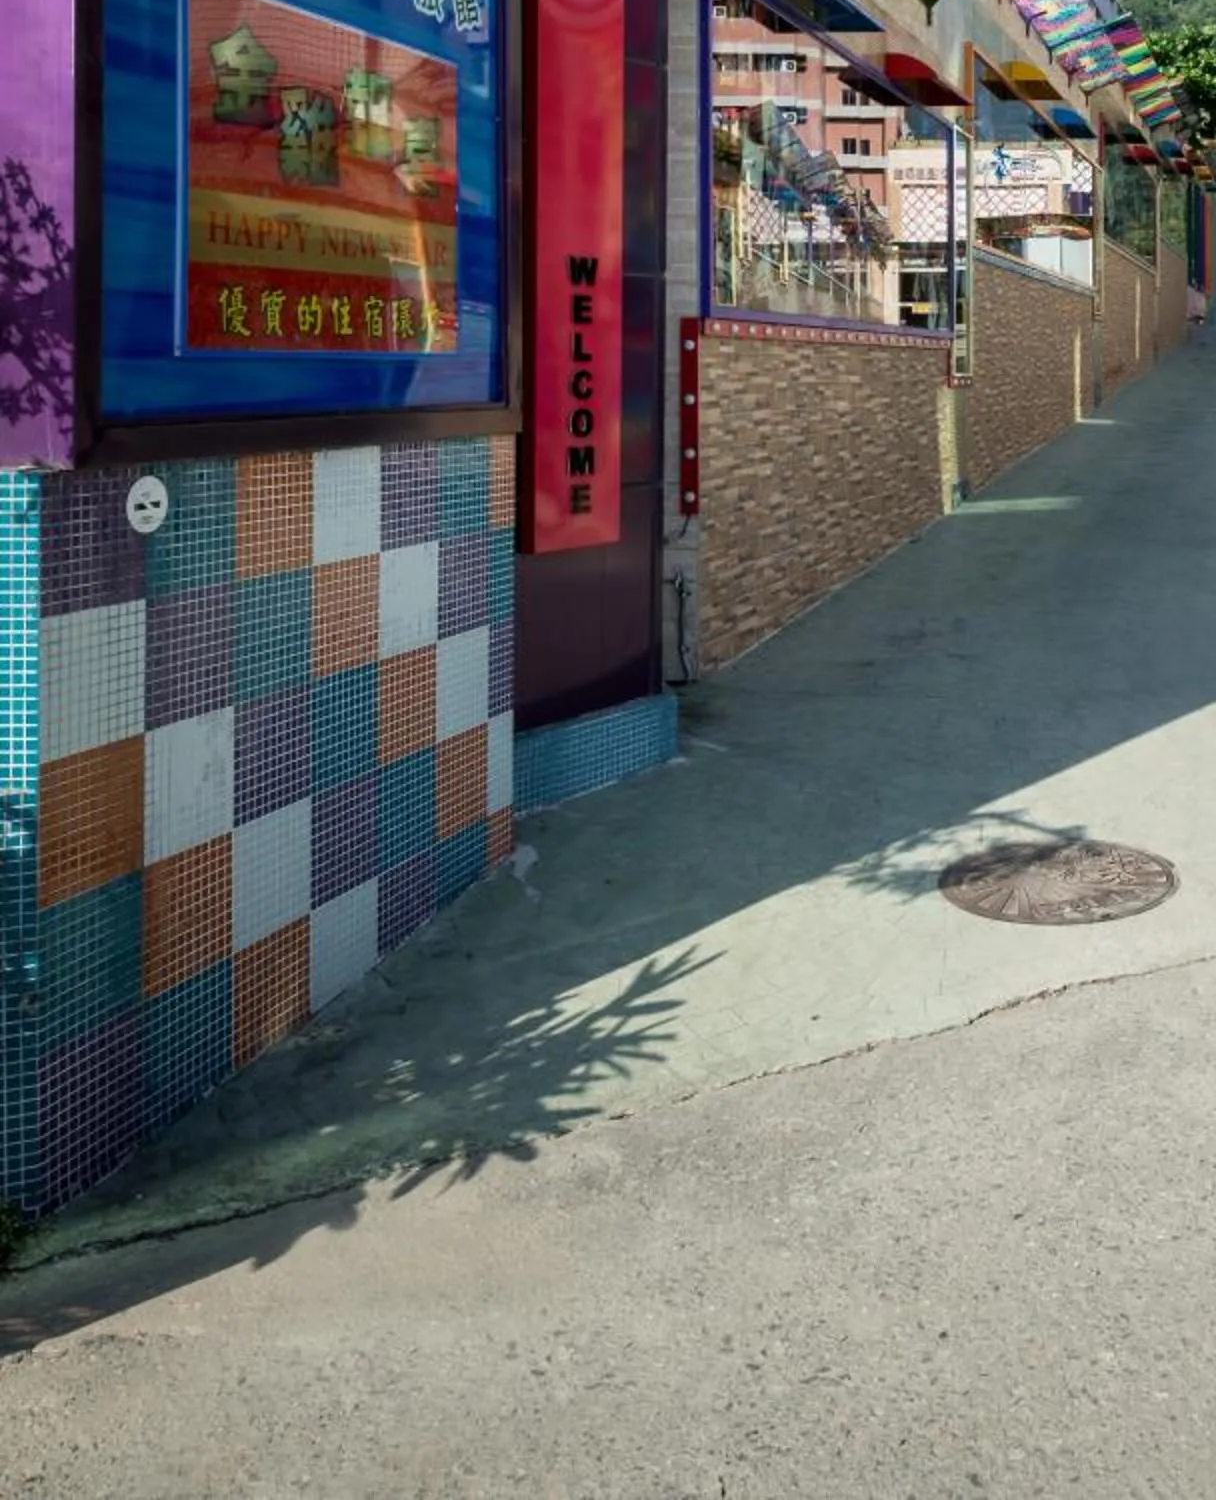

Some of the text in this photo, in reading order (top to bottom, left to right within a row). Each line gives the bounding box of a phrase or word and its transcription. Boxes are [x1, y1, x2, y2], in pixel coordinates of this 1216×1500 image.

[206, 209, 310, 252] HAPPY
[320, 223, 377, 258] NEW
[567, 255, 598, 516] WELCOME
